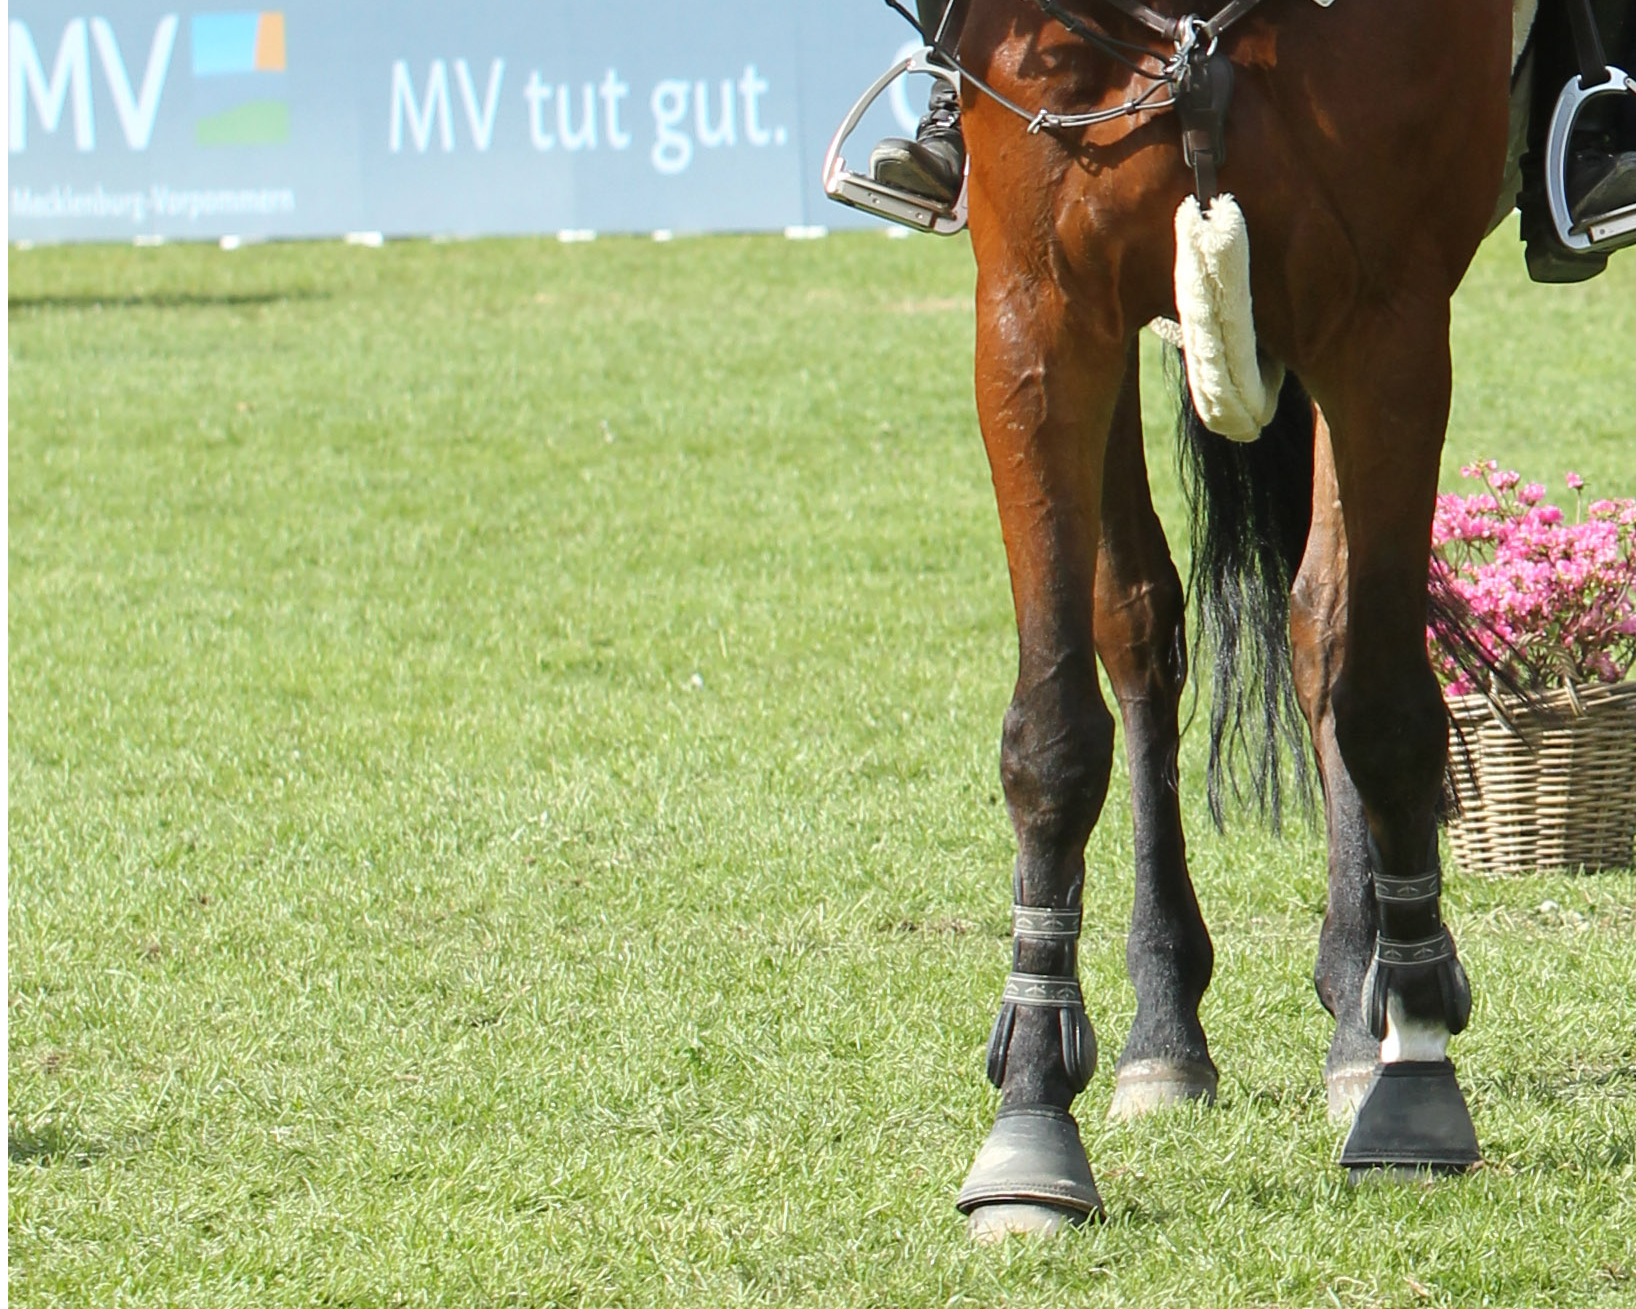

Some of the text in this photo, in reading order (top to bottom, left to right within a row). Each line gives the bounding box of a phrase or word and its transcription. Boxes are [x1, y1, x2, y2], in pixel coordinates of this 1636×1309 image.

[8, 12, 180, 153] MV
[388, 56, 506, 154] MV
[524, 66, 632, 152] tut
[650, 61, 789, 176] gut.
